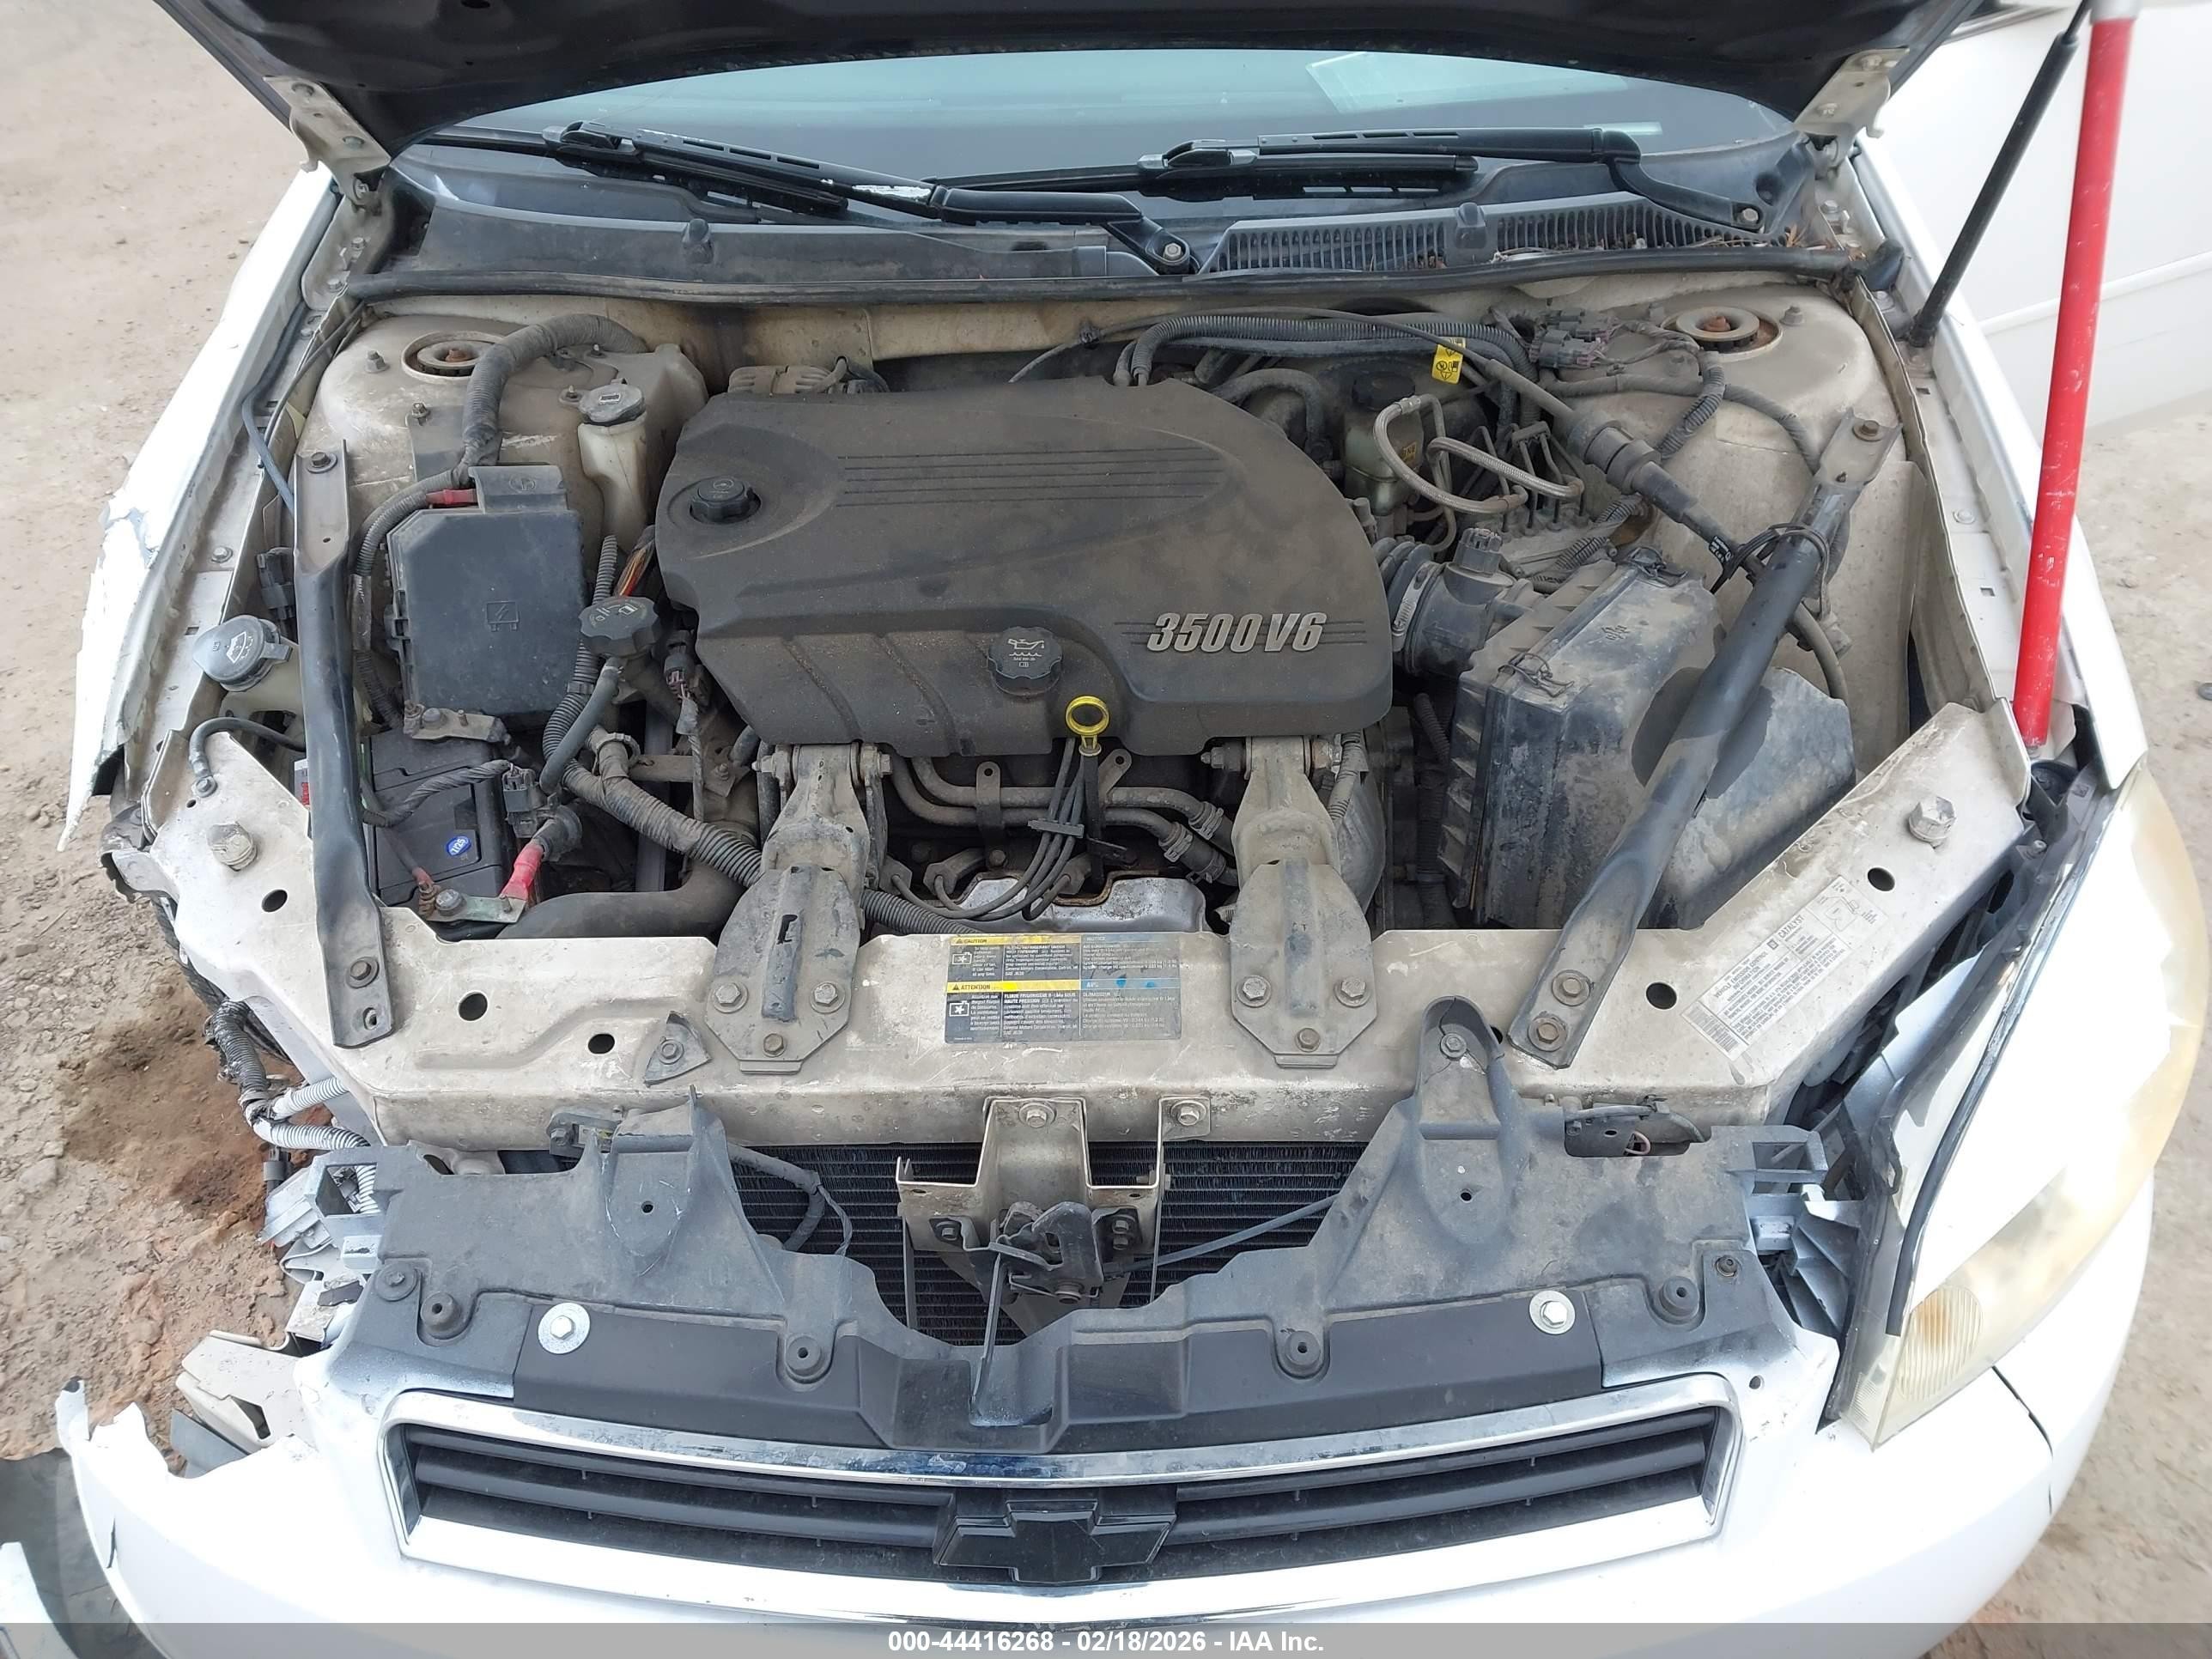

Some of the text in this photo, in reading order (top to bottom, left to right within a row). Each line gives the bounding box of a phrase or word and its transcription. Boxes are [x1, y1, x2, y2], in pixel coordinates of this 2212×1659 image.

[1147, 611, 1328, 653] 3500 V6
[1777, 913, 1805, 940] CATALYST
